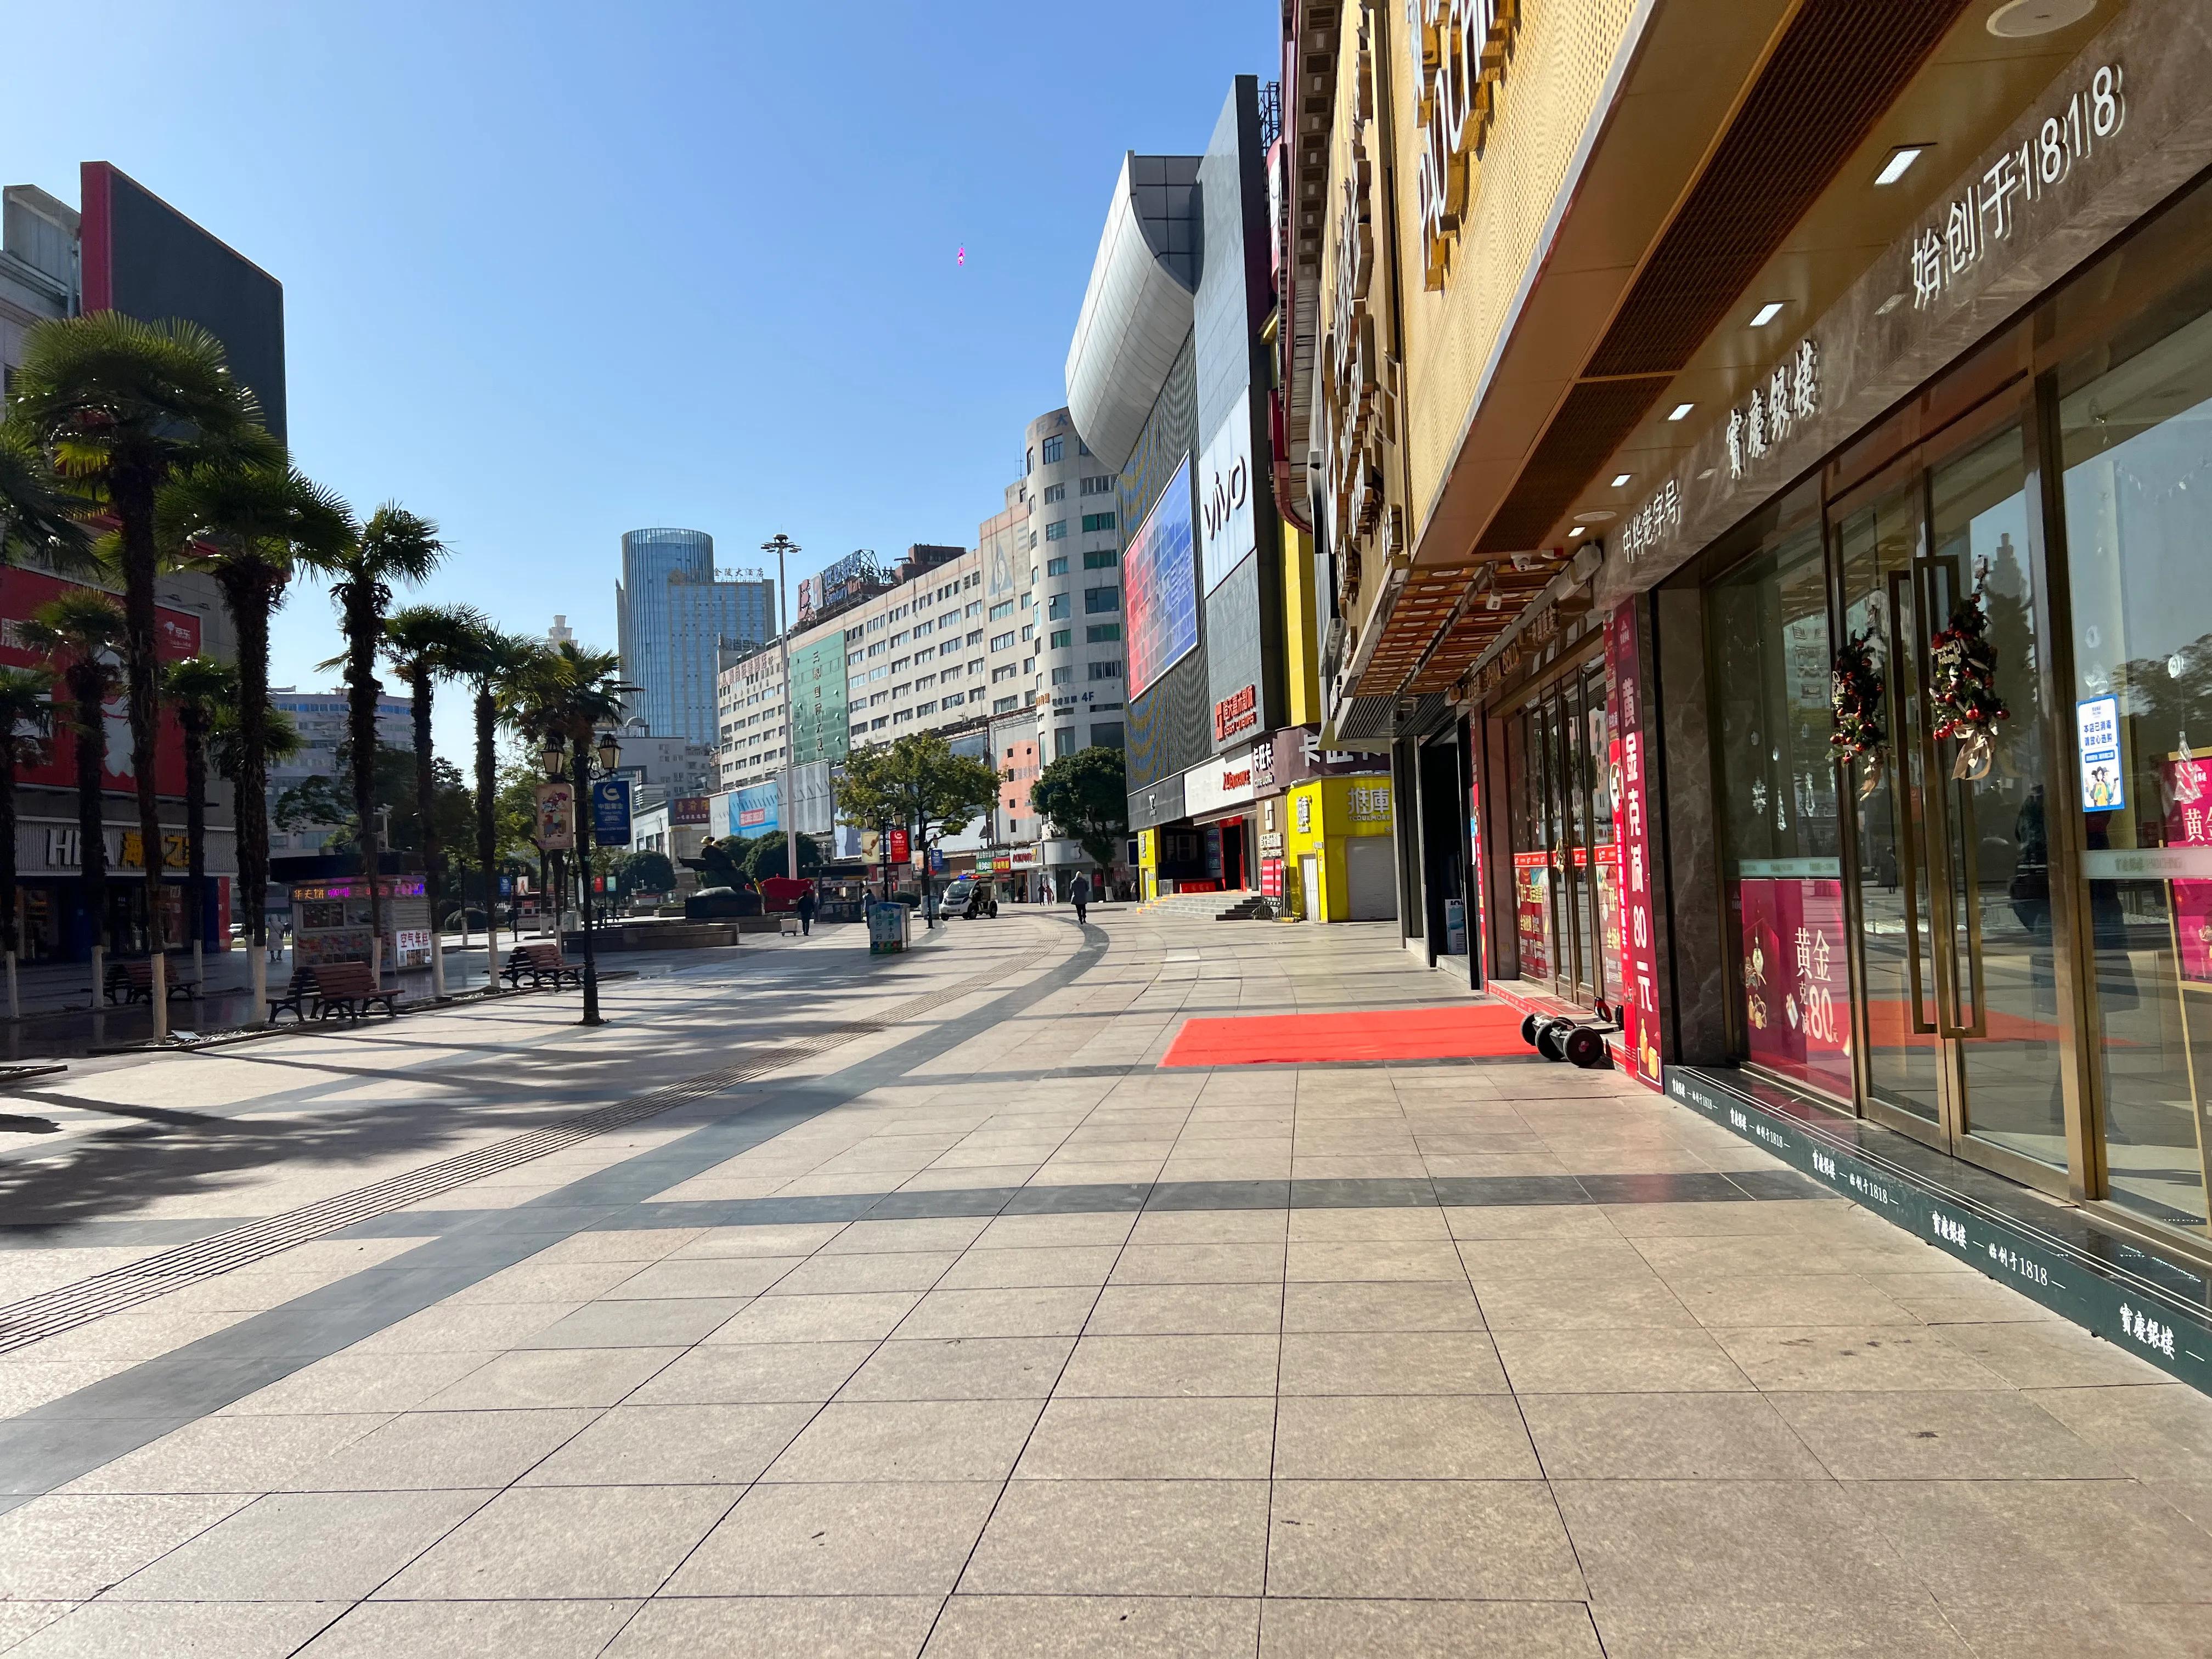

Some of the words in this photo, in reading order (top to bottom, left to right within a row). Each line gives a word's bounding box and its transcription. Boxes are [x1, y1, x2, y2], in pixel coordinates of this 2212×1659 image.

[1911, 65, 2119, 309] 始创于1818
[1204, 456, 1246, 540] vivo
[1623, 479, 1680, 562] 中华老字号
[714, 567, 763, 577] 金陵大酒店
[1081, 691, 1094, 702] 4F
[2084, 720, 2111, 733] 本店已消毒
[2085, 733, 2112, 746] 请放心选购
[1253, 742, 1273, 772] 卡旺卡
[294, 888, 324, 900] 华夫饼
[328, 887, 351, 898] 咖啡
[1795, 927, 1831, 982] 黄金
[1989, 1242, 2048, 1286] 始创于1818
